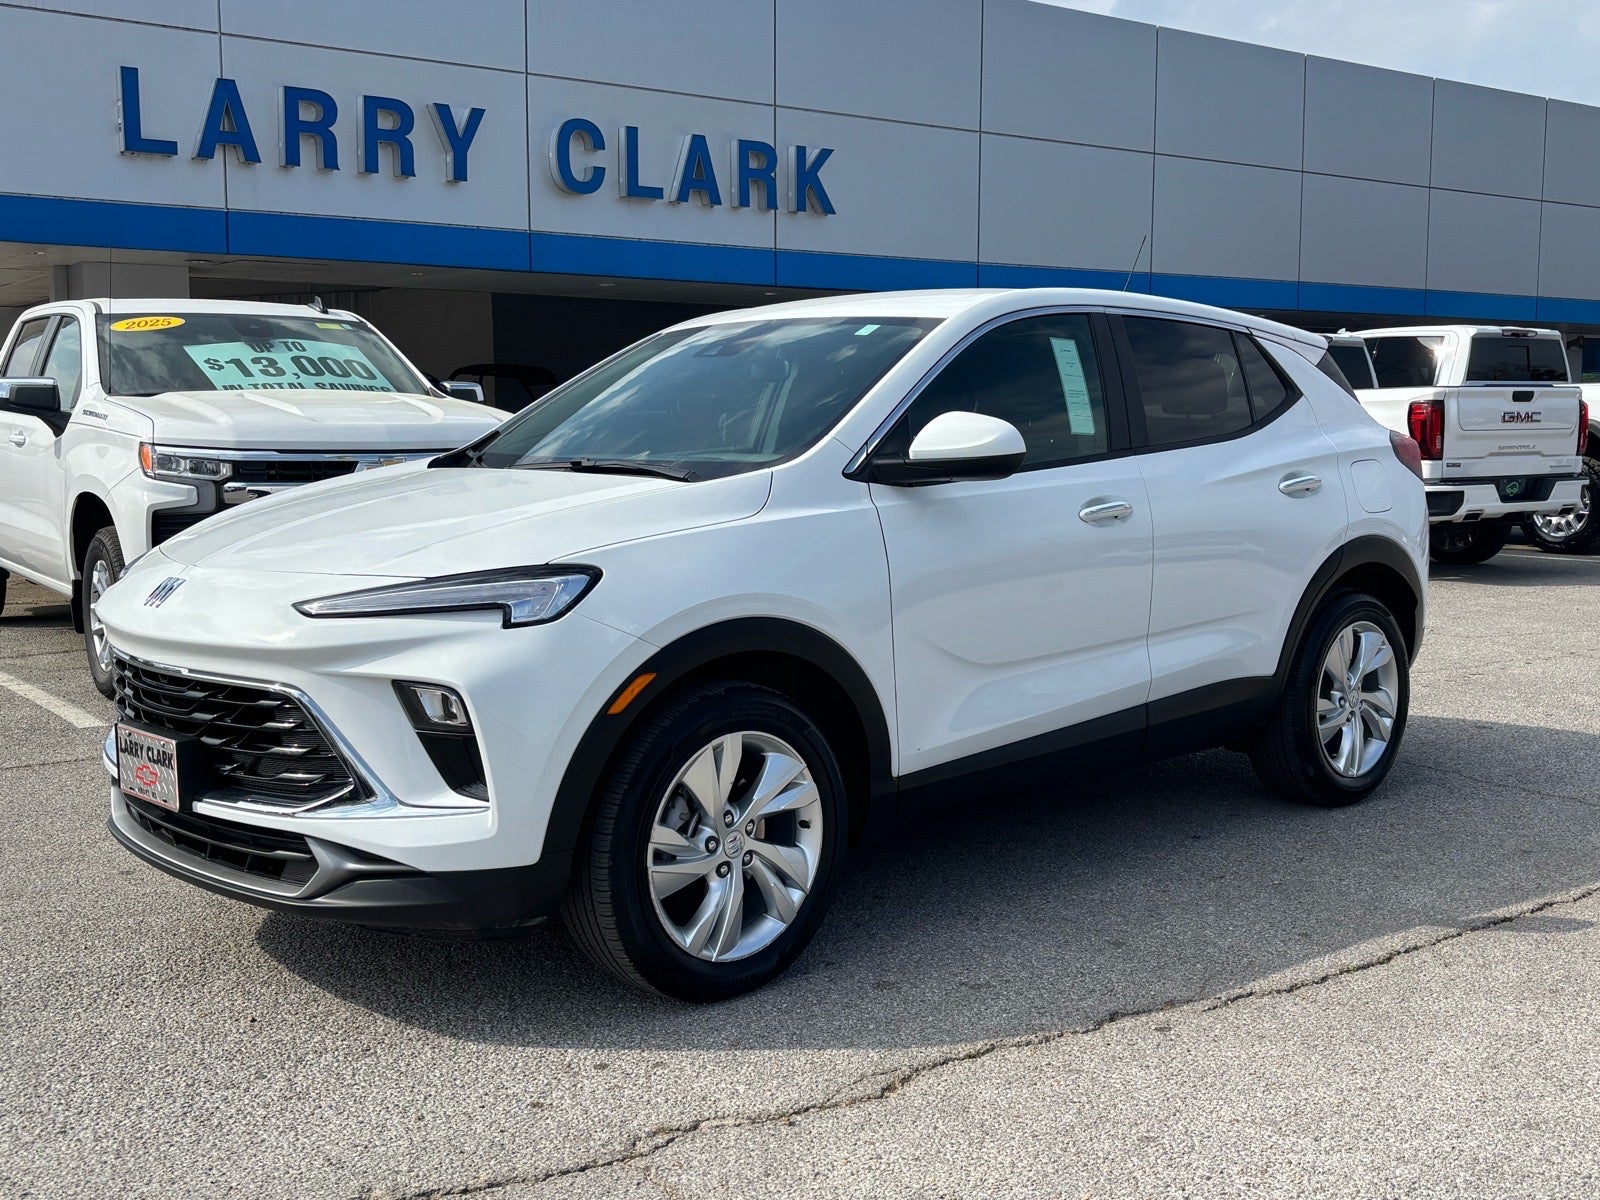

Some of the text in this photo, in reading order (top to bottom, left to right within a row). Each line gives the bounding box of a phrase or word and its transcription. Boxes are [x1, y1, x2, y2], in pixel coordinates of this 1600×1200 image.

[117, 65, 836, 216] LARRY CLARK
[124, 318, 172, 330] 2025
[251, 341, 307, 353] UP TO
[203, 355, 378, 380] $13,000
[1501, 411, 1542, 423] GMC
[120, 737, 174, 769] LARRY CLARK
